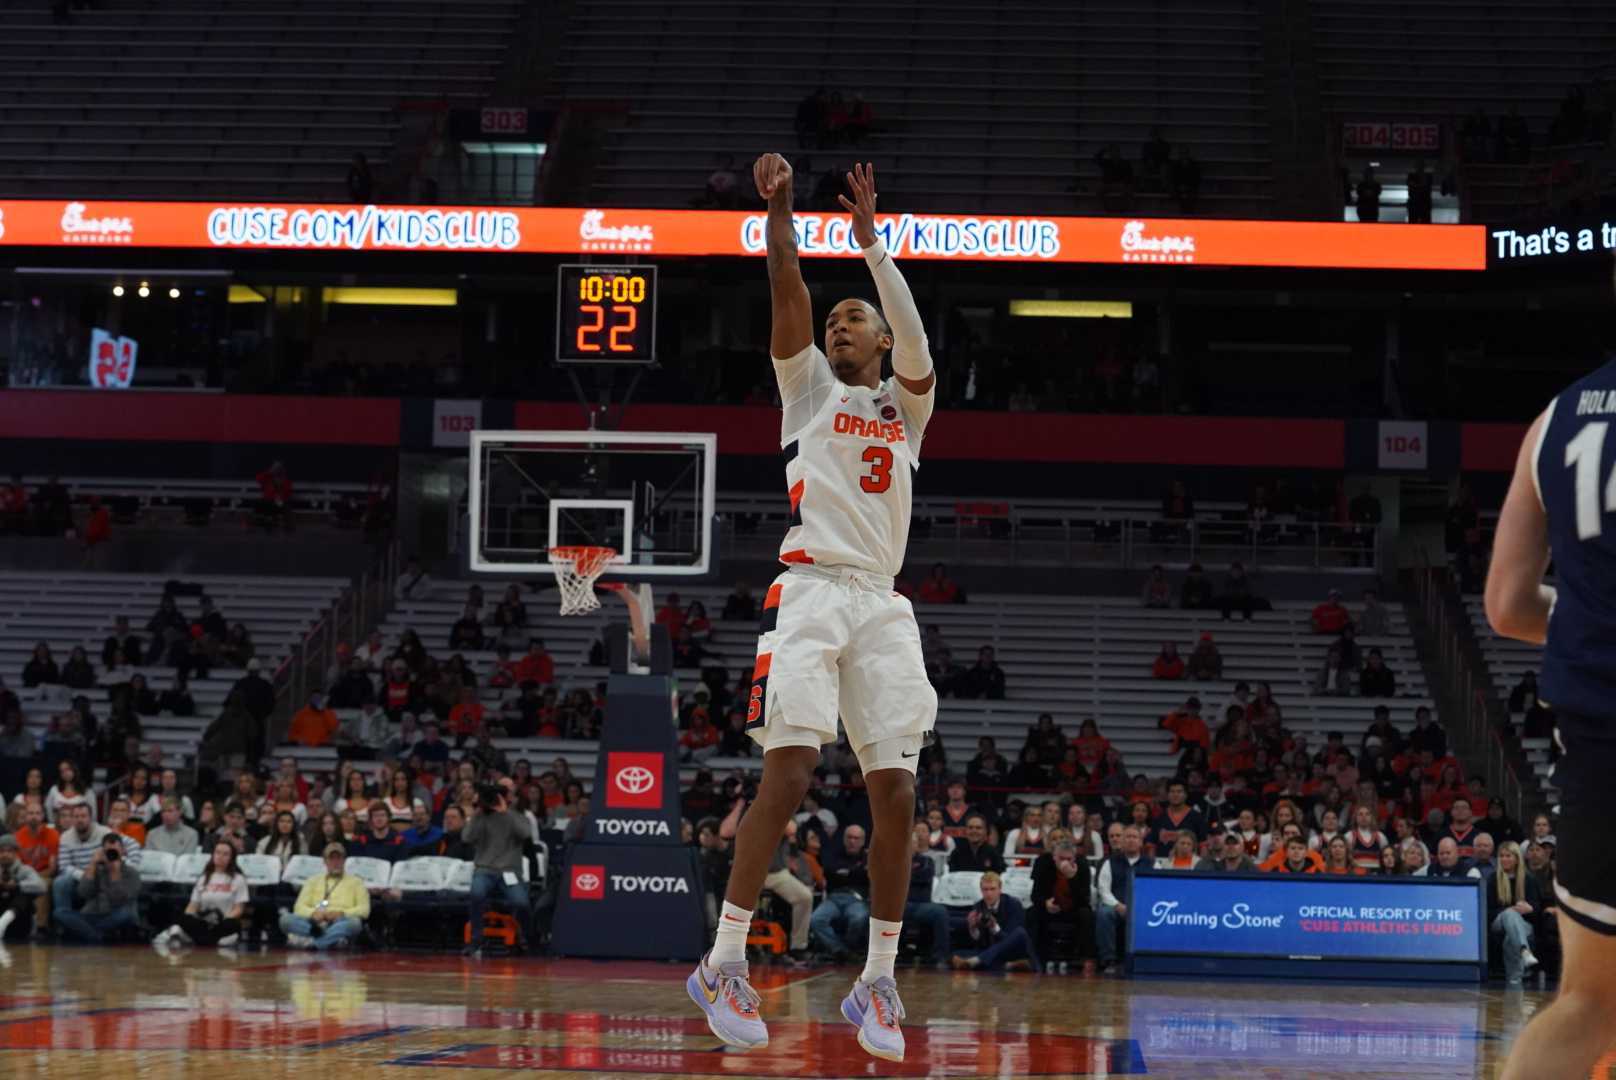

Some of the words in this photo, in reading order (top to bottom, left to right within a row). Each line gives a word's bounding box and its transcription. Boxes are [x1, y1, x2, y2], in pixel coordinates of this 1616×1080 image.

[482, 111, 526, 129] 303
[1394, 127, 1438, 146] 305
[209, 206, 518, 249] CUSE.COM/KIDSCLUB
[1492, 226, 1570, 258] That's
[1577, 228, 1593, 251] a
[580, 276, 645, 303] 10:00
[577, 305, 637, 351] 22
[441, 415, 475, 432] 103
[1384, 436, 1421, 453] 104
[859, 446, 894, 494] 3
[596, 819, 671, 836] TOYOTA
[611, 875, 689, 893] TOYOTA
[1147, 901, 1218, 929] Turning
[1222, 902, 1284, 928] Stone
[1299, 906, 1356, 919] OFFICIAL
[1360, 907, 1411, 920] RESORT
[1414, 909, 1433, 921] OF
[1436, 909, 1463, 921] THE
[1343, 921, 1420, 934] ATHLETICS
[1423, 923, 1463, 936] FUND
